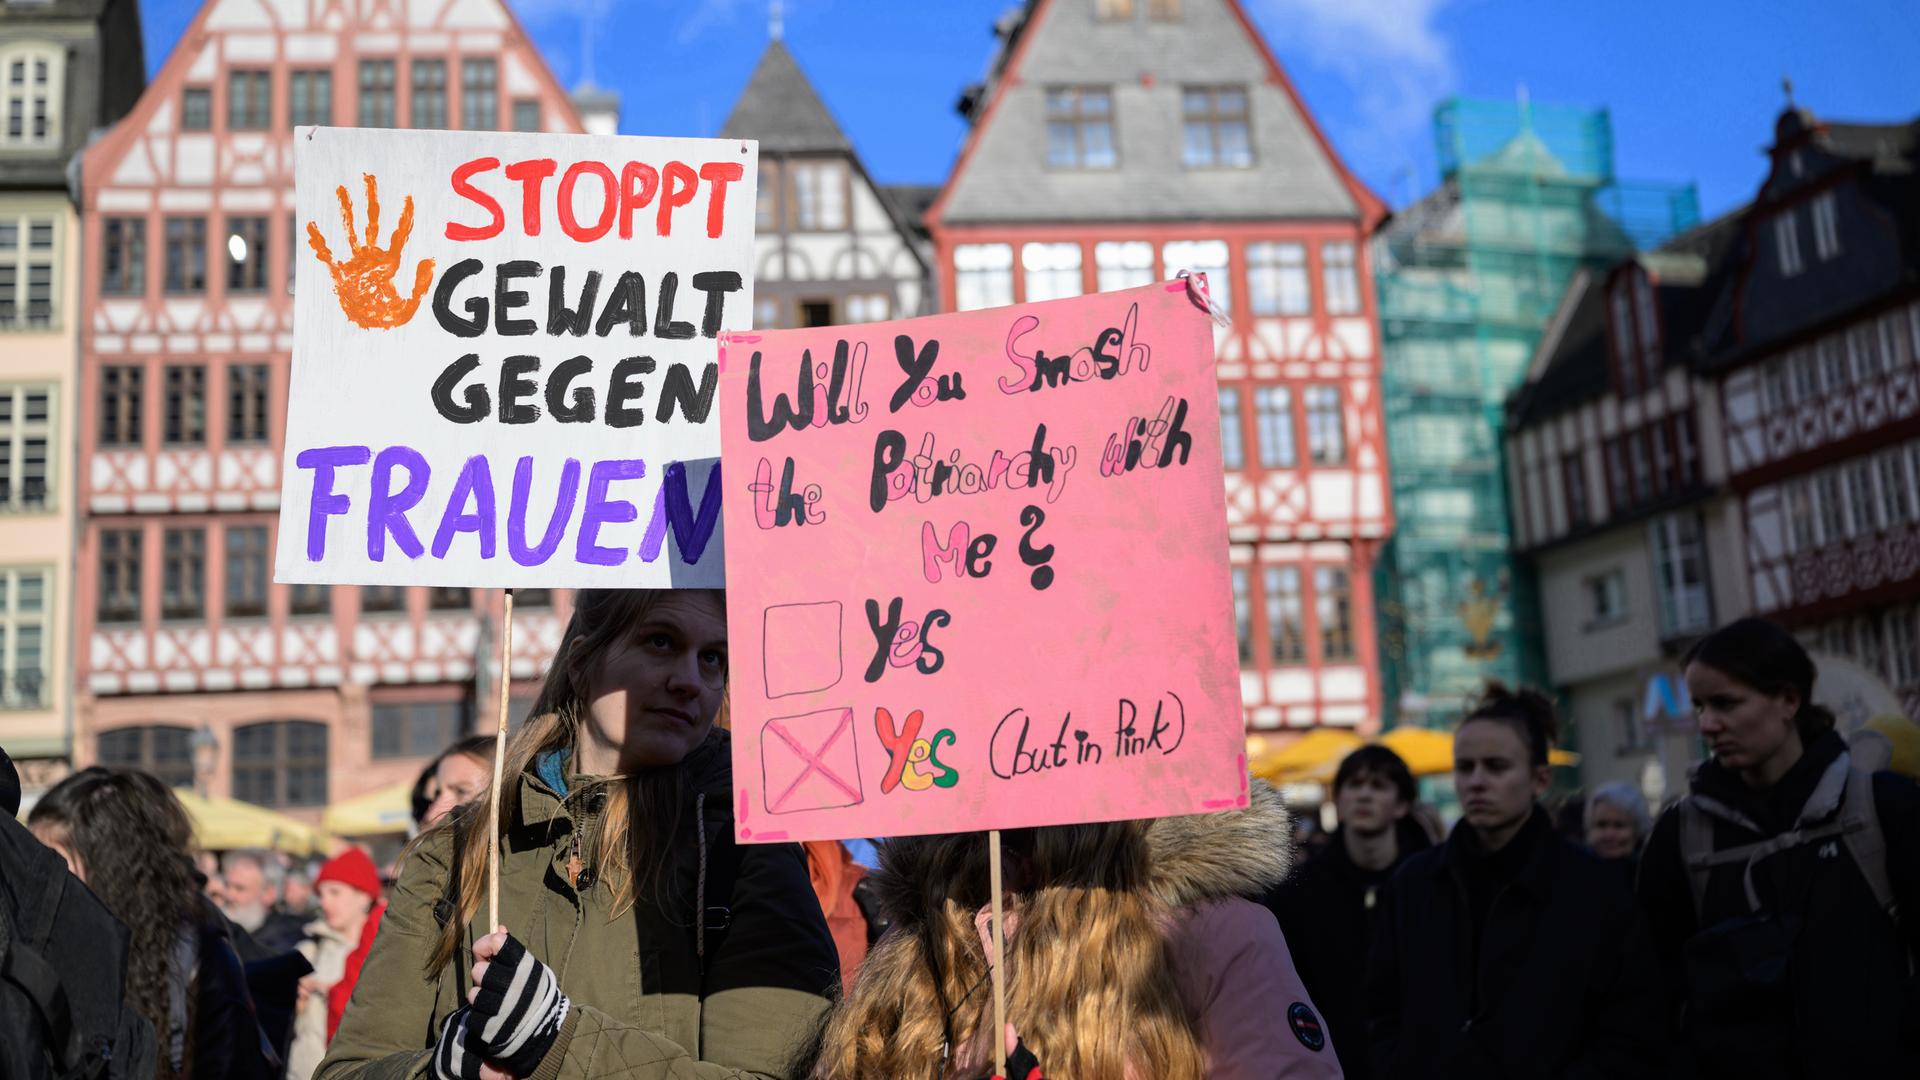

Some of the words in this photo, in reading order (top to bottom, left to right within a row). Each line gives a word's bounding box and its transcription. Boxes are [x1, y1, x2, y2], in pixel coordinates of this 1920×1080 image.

[445, 157, 744, 242] STOPPT
[432, 258, 743, 338] GEWALT
[431, 353, 718, 428] GEGEN
[747, 339, 869, 441] Will
[890, 334, 966, 413] You
[998, 302, 1151, 395] Smash
[296, 446, 722, 567] FRAUEN
[747, 457, 826, 530] the
[870, 423, 1077, 513] Patriarchy
[1100, 396, 1191, 477] with
[864, 596, 951, 683] Yes
[875, 707, 960, 795] Yes
[989, 708, 1070, 780] (but
[1074, 730, 1102, 765] in
[1115, 691, 1186, 758] Pink)
